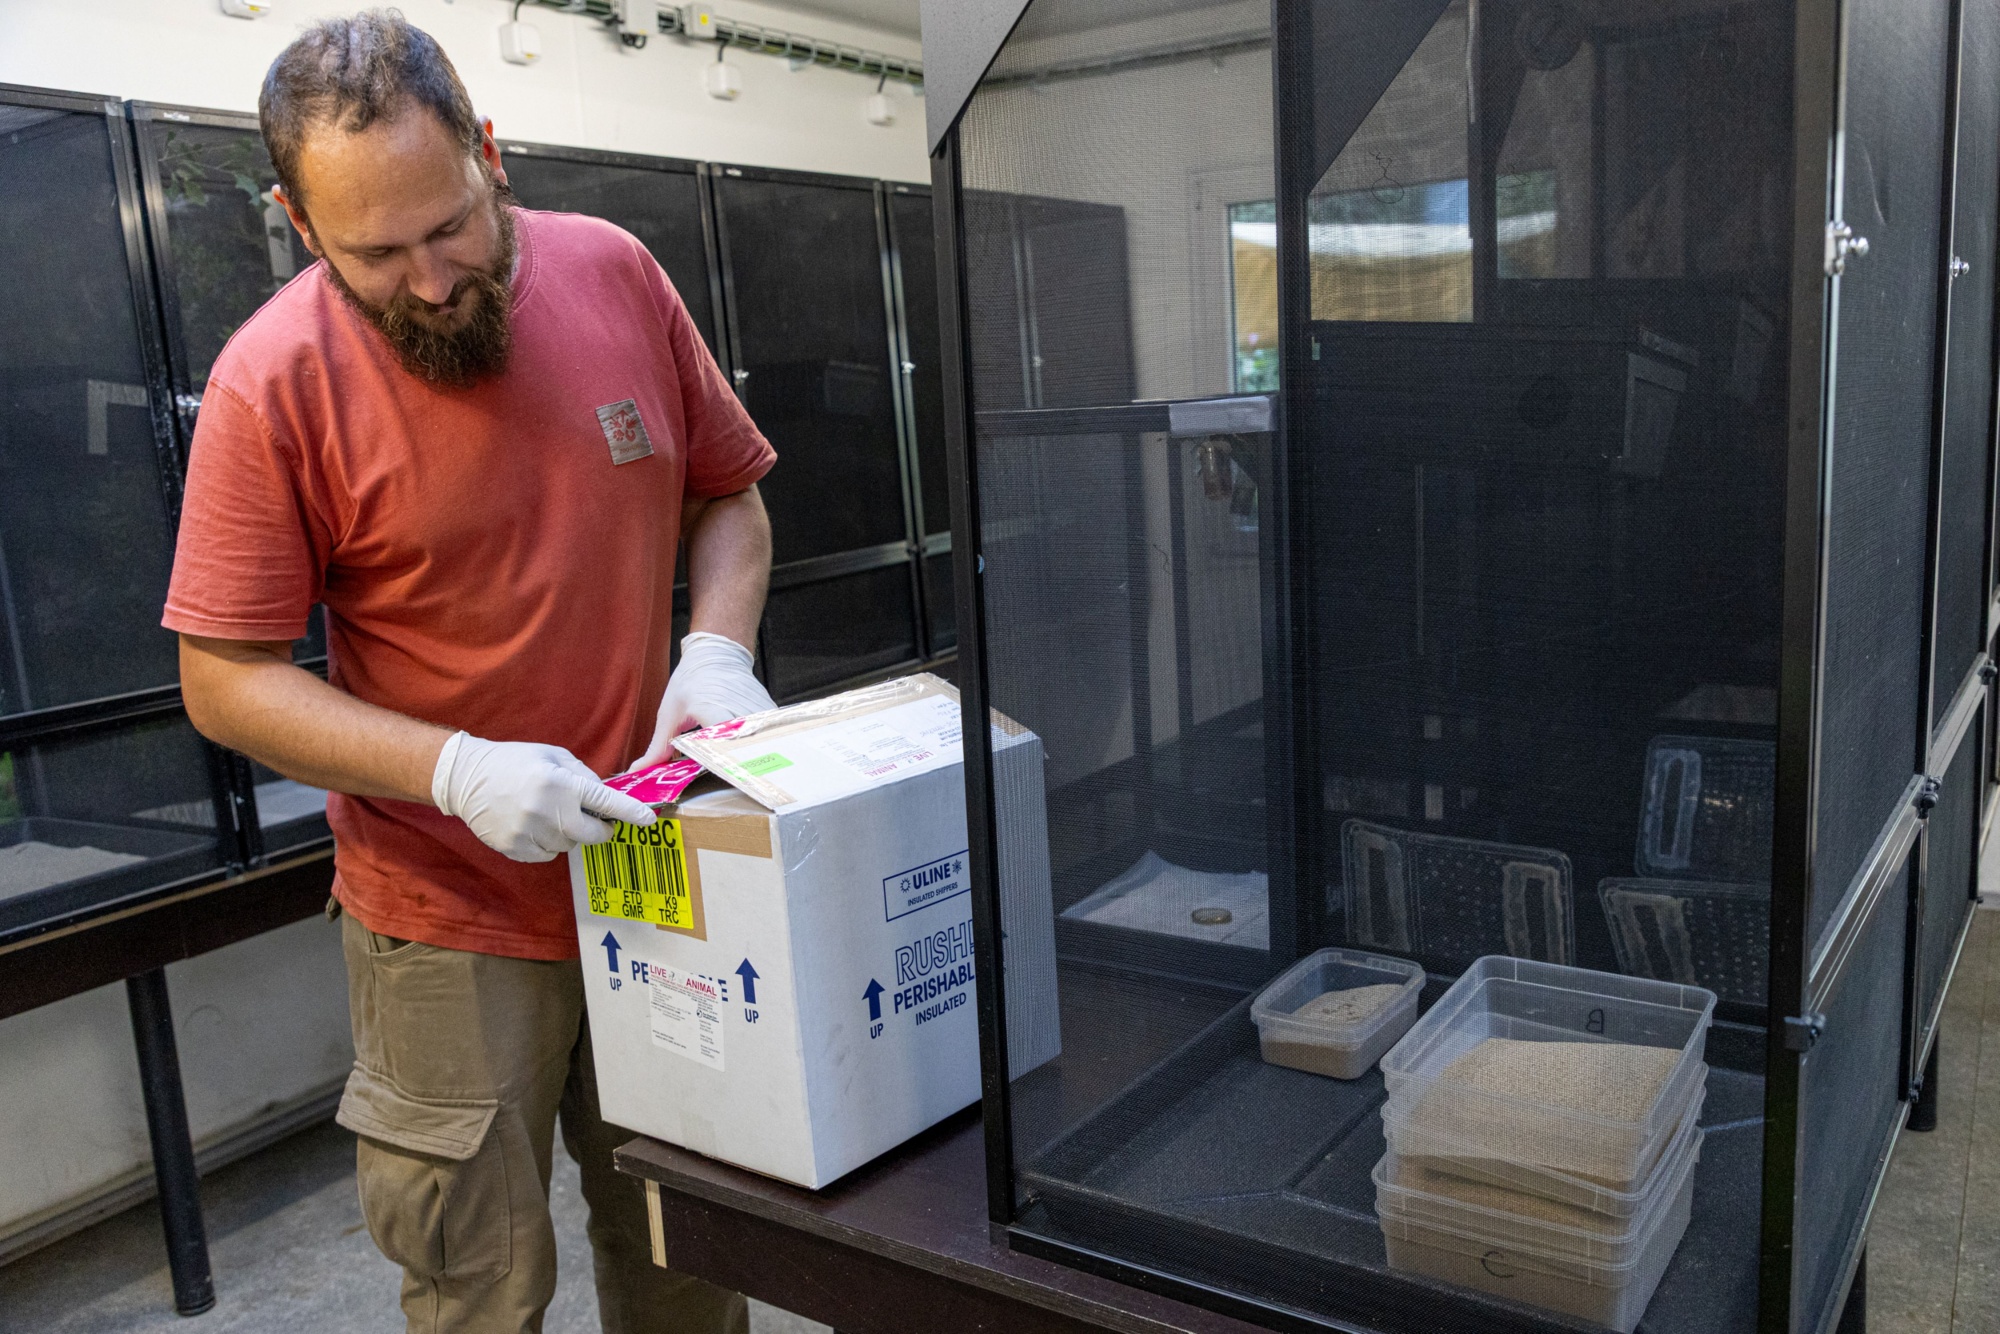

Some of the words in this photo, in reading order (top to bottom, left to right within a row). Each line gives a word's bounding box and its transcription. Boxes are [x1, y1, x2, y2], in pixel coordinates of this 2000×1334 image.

[912, 862, 951, 890] ULINE
[590, 887, 608, 900] XRY
[623, 891, 643, 905] ETD
[665, 896, 678, 910] K9
[907, 891, 935, 907] INSULATED
[935, 881, 959, 897] SHIPPERS
[591, 899, 610, 914] DLP
[622, 904, 645, 919] GMR
[659, 908, 679, 924] TRC
[609, 977, 622, 992] UP
[650, 964, 667, 979] LIVE
[686, 978, 717, 997] ANIMAL
[893, 962, 975, 1014] PERISHABL
[744, 1008, 760, 1024] UP
[915, 992, 967, 1026] INSULATED
[870, 1023, 884, 1040] UP
